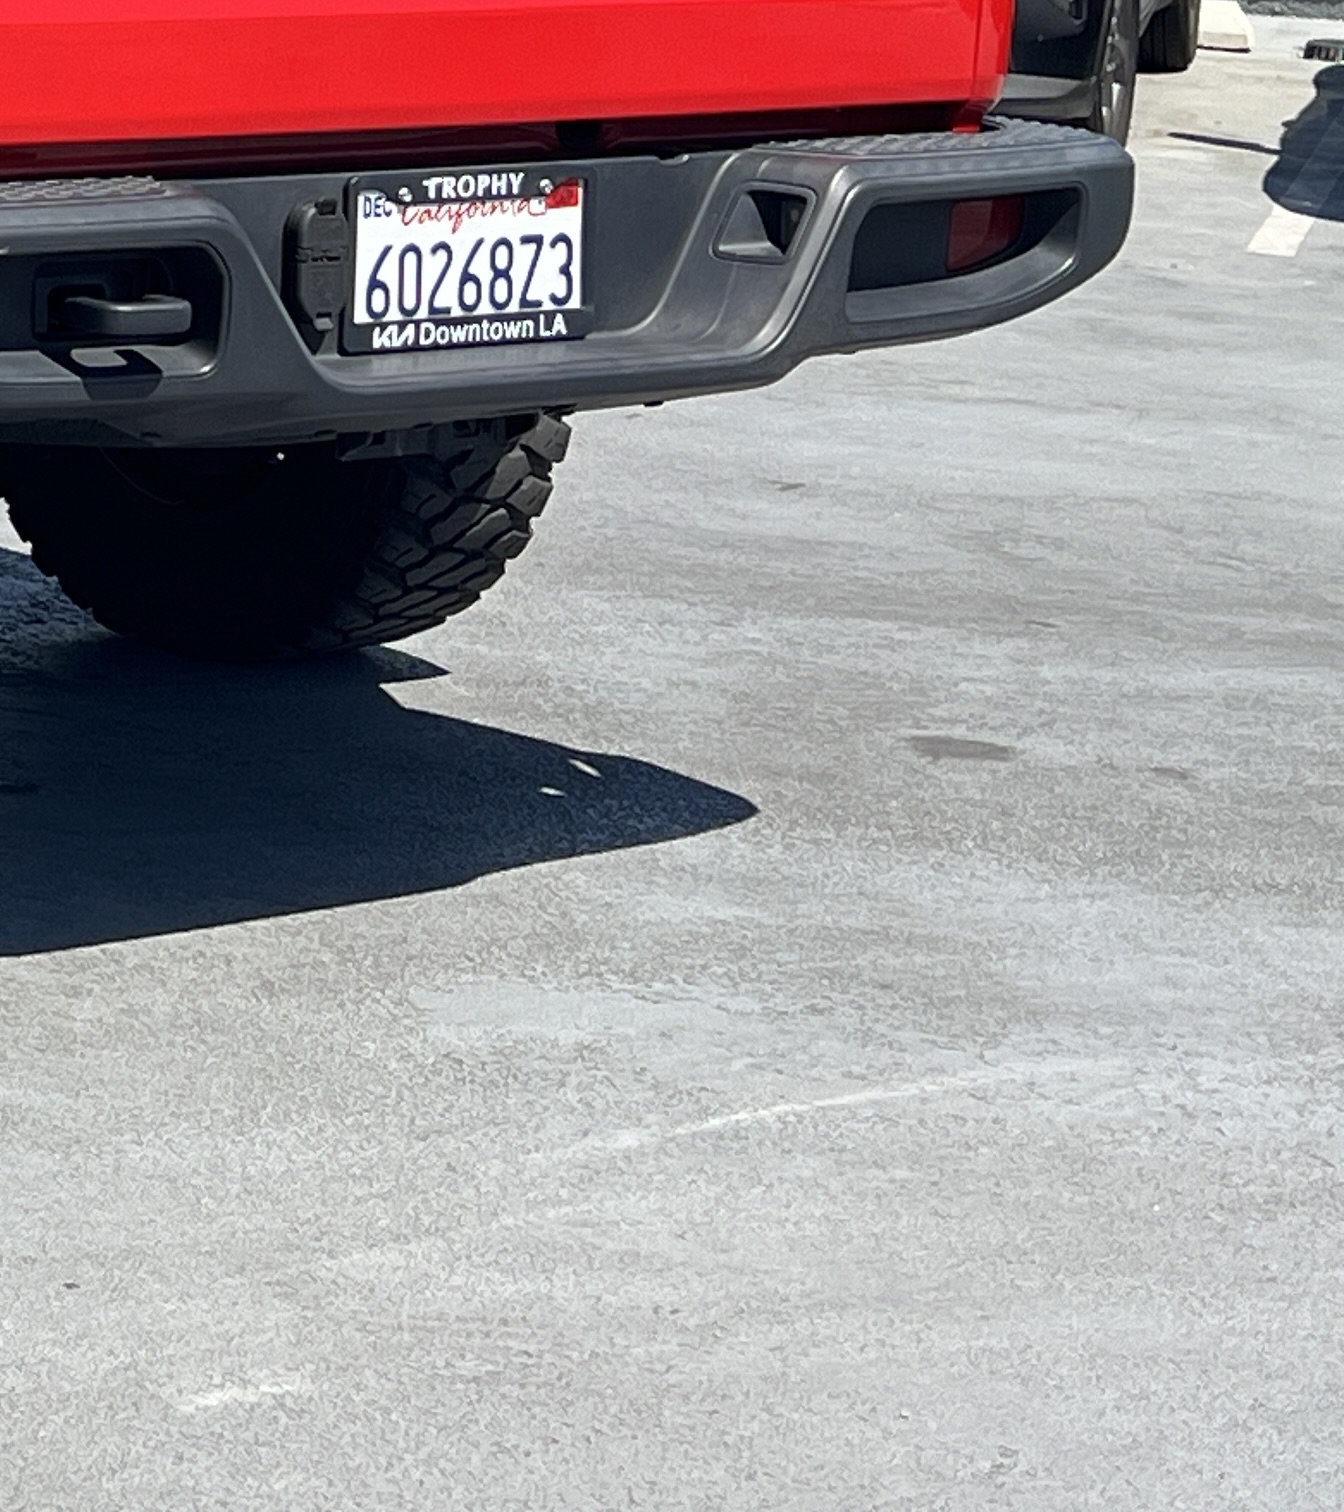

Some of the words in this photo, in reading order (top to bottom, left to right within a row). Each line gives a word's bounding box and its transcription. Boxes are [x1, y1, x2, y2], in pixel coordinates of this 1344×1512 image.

[422, 172, 526, 199] TROPHY
[363, 195, 392, 219] DEC
[365, 232, 574, 320] 60268Z3
[419, 317, 534, 345] Downtown
[539, 313, 568, 337] LA
